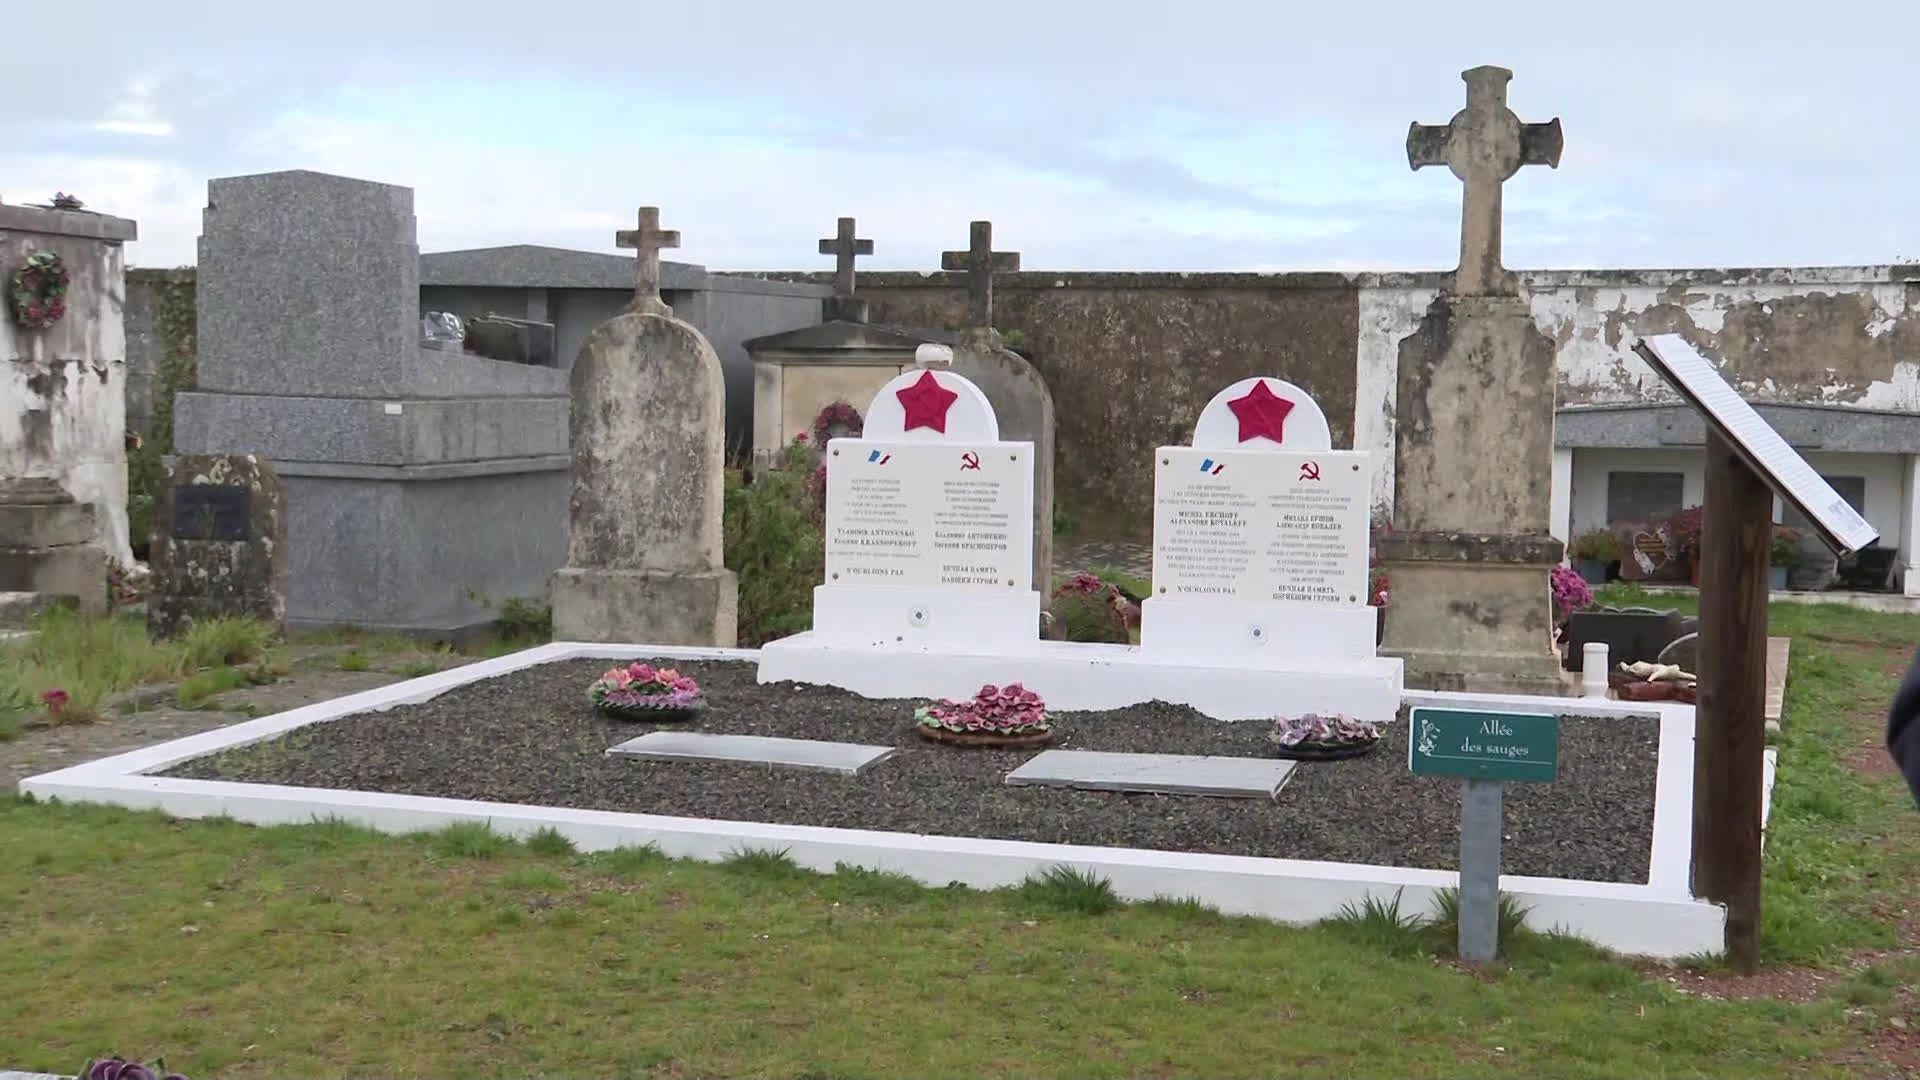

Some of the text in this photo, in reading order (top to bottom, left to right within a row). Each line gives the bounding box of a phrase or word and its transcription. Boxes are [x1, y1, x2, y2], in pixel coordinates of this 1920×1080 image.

[1480, 719, 1513, 736] Allée
[1460, 736, 1529, 758] des sauges
